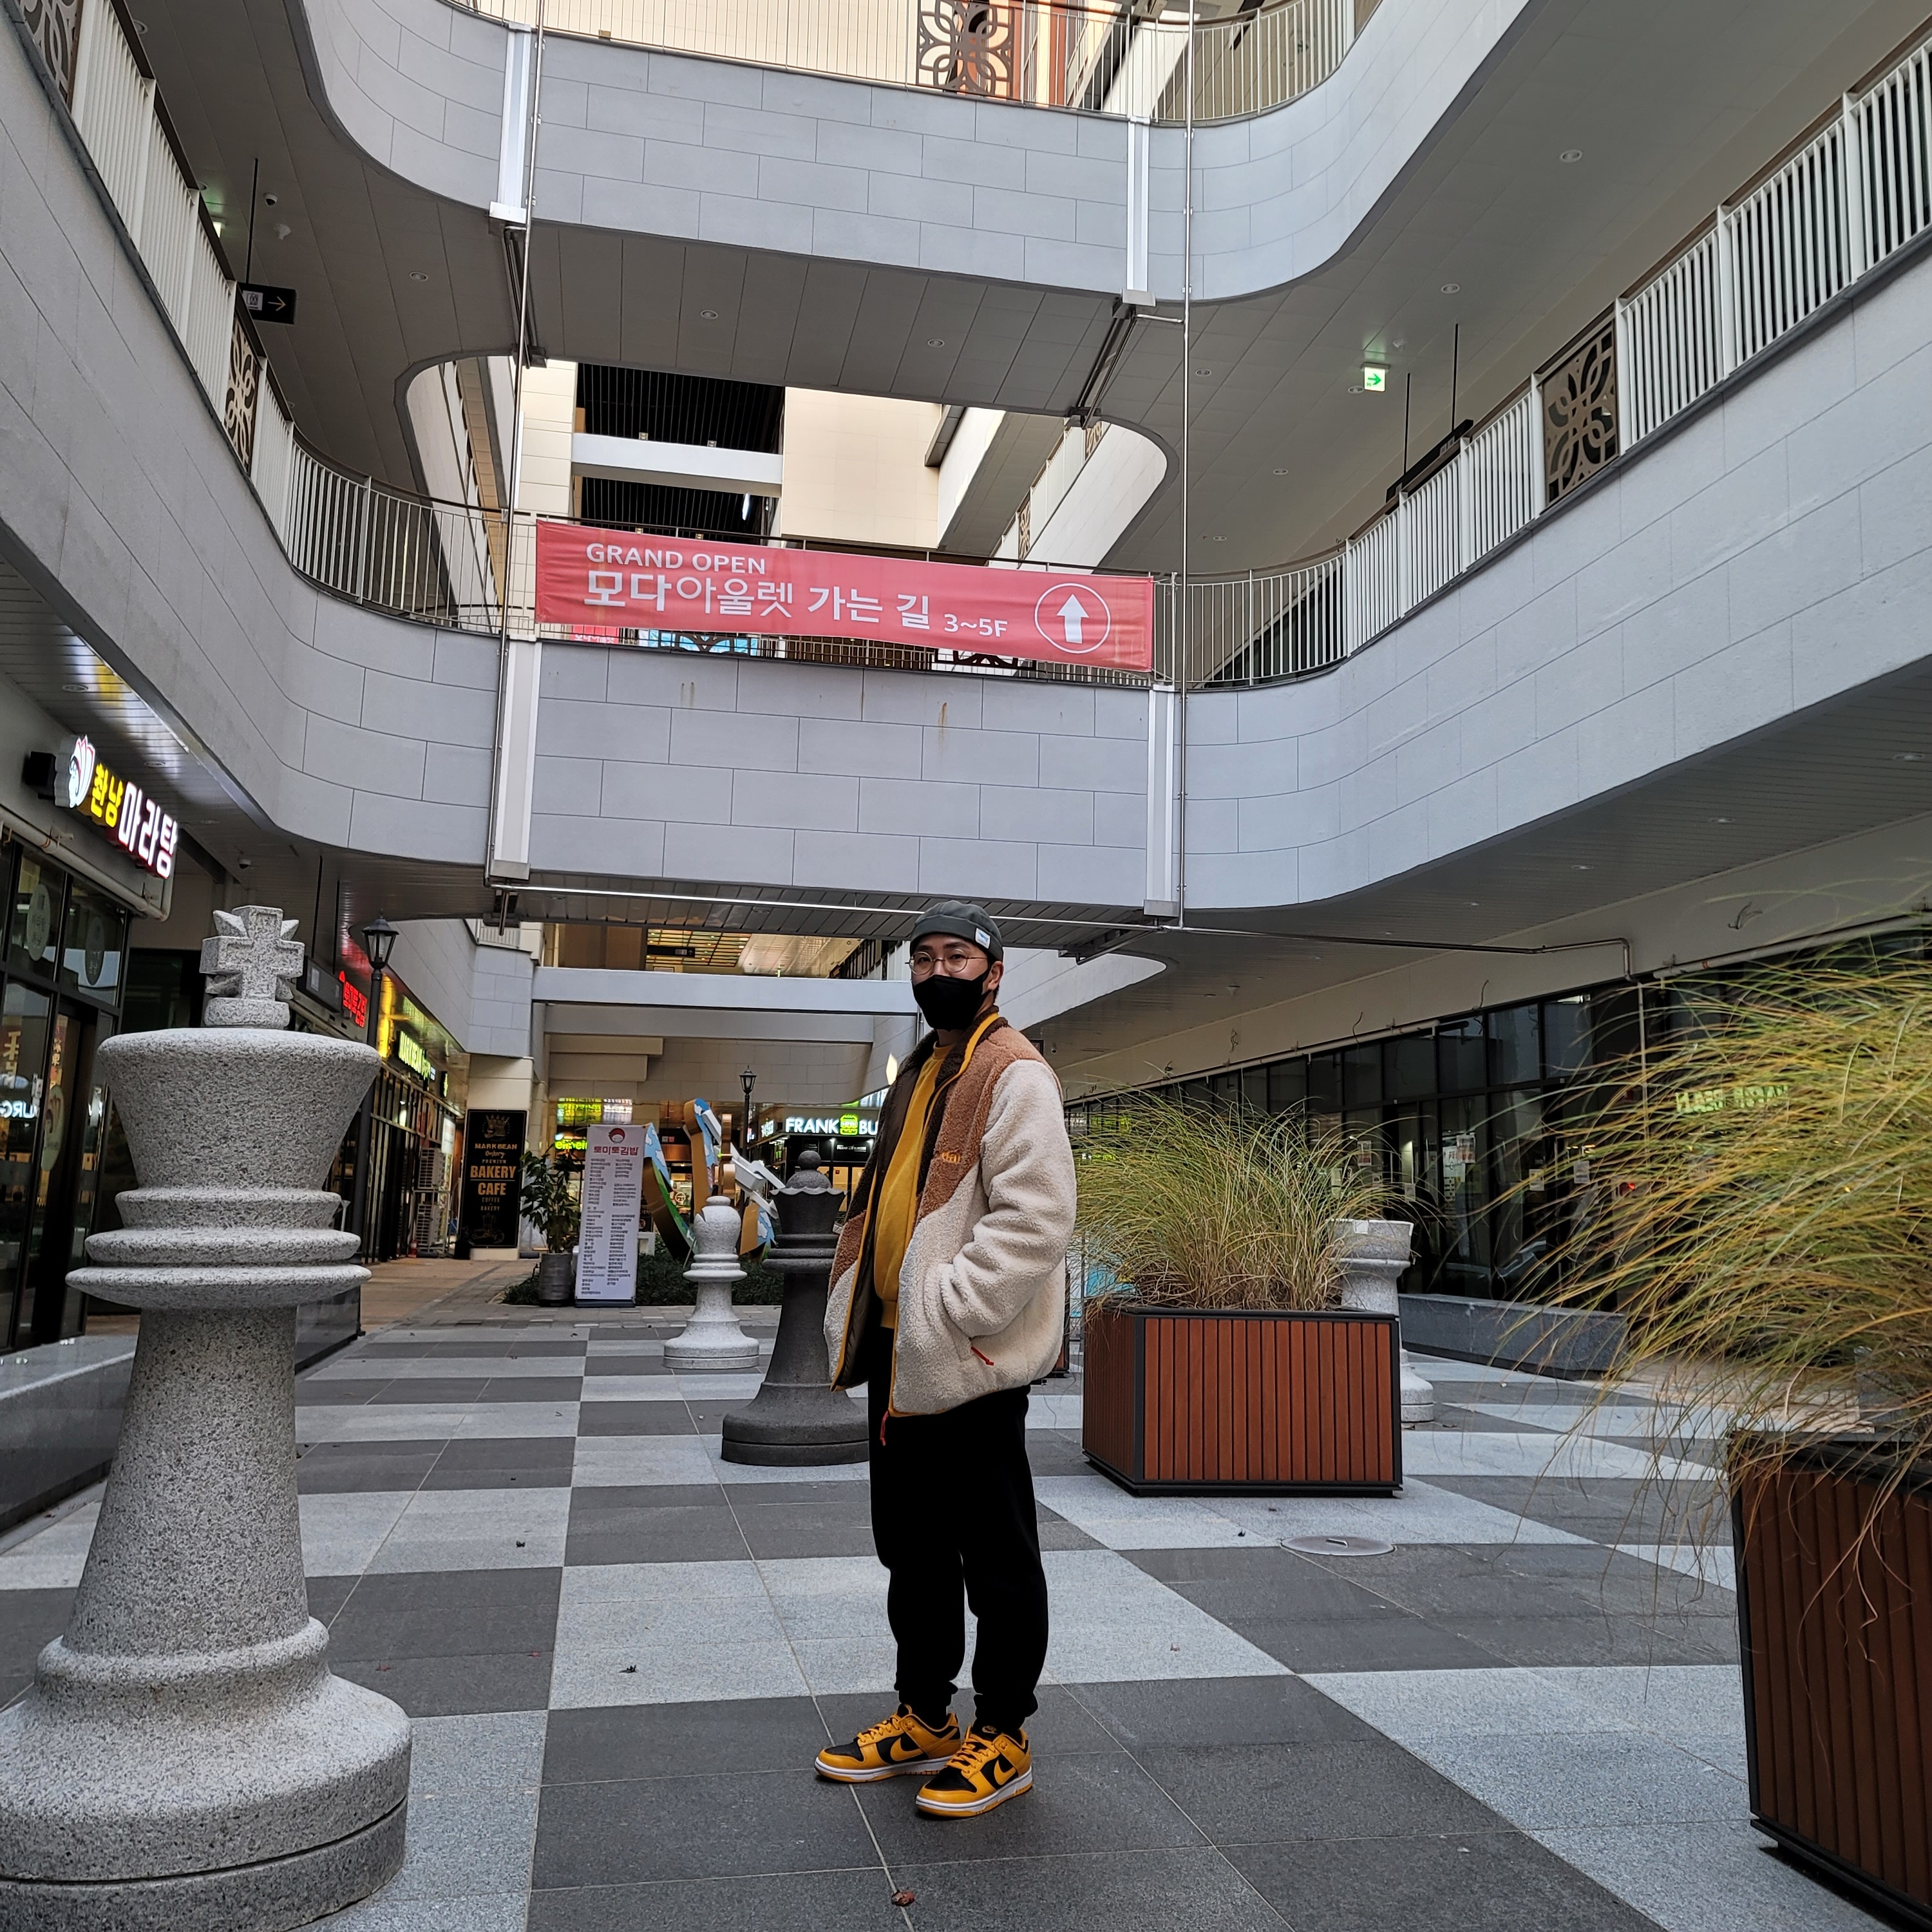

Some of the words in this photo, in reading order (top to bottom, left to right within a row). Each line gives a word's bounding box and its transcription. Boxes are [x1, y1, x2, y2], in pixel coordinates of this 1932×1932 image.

[587, 543, 683, 570] GRAND
[692, 552, 766, 575] OPEN
[584, 570, 793, 618] 모다아울렛
[809, 587, 882, 625] 가는
[896, 594, 931, 630] 길
[943, 612, 1009, 638] 3~5F
[118, 782, 178, 879] 마라탕
[785, 1118, 840, 1134] FRANK
[593, 1146, 639, 1156] 토마토김밥
[469, 1165, 517, 1179] BAKERY
[477, 1182, 507, 1195] CAFE
